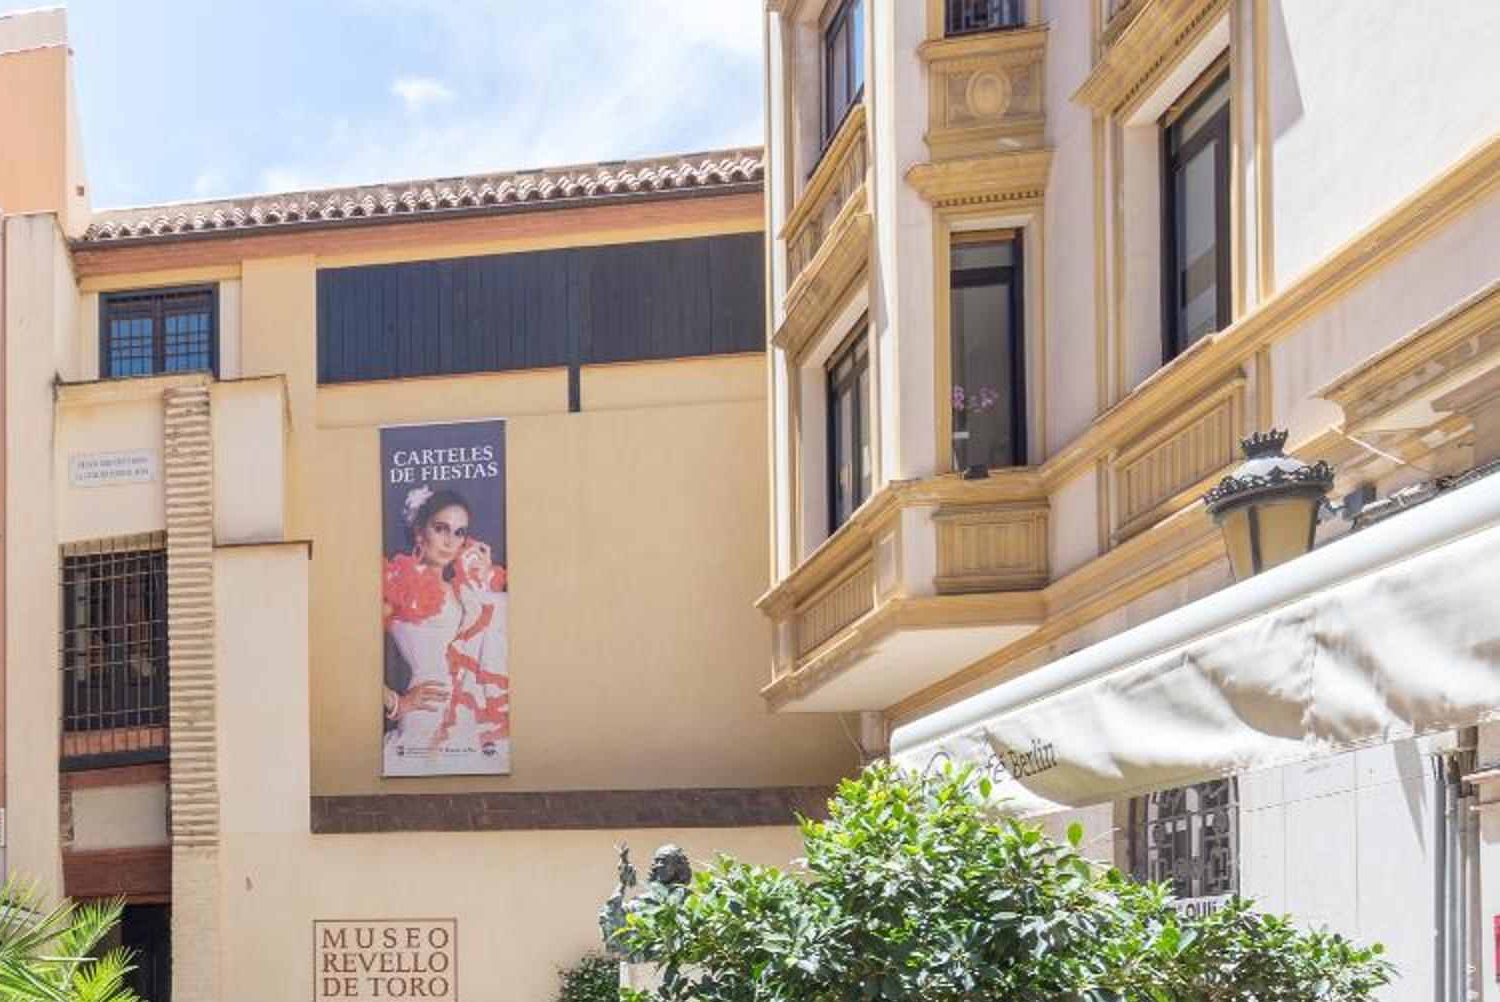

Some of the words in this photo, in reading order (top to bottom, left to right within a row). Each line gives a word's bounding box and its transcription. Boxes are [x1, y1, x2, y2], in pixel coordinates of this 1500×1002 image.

[393, 445, 494, 467] CARTELES
[390, 467, 415, 483] DE
[421, 461, 498, 481] FIESTAS
[1008, 738, 1058, 779] Berlin
[321, 927, 450, 949] MUSEO
[321, 951, 450, 973] REVELLO
[321, 976, 359, 997] DE
[367, 976, 450, 997] TORO
